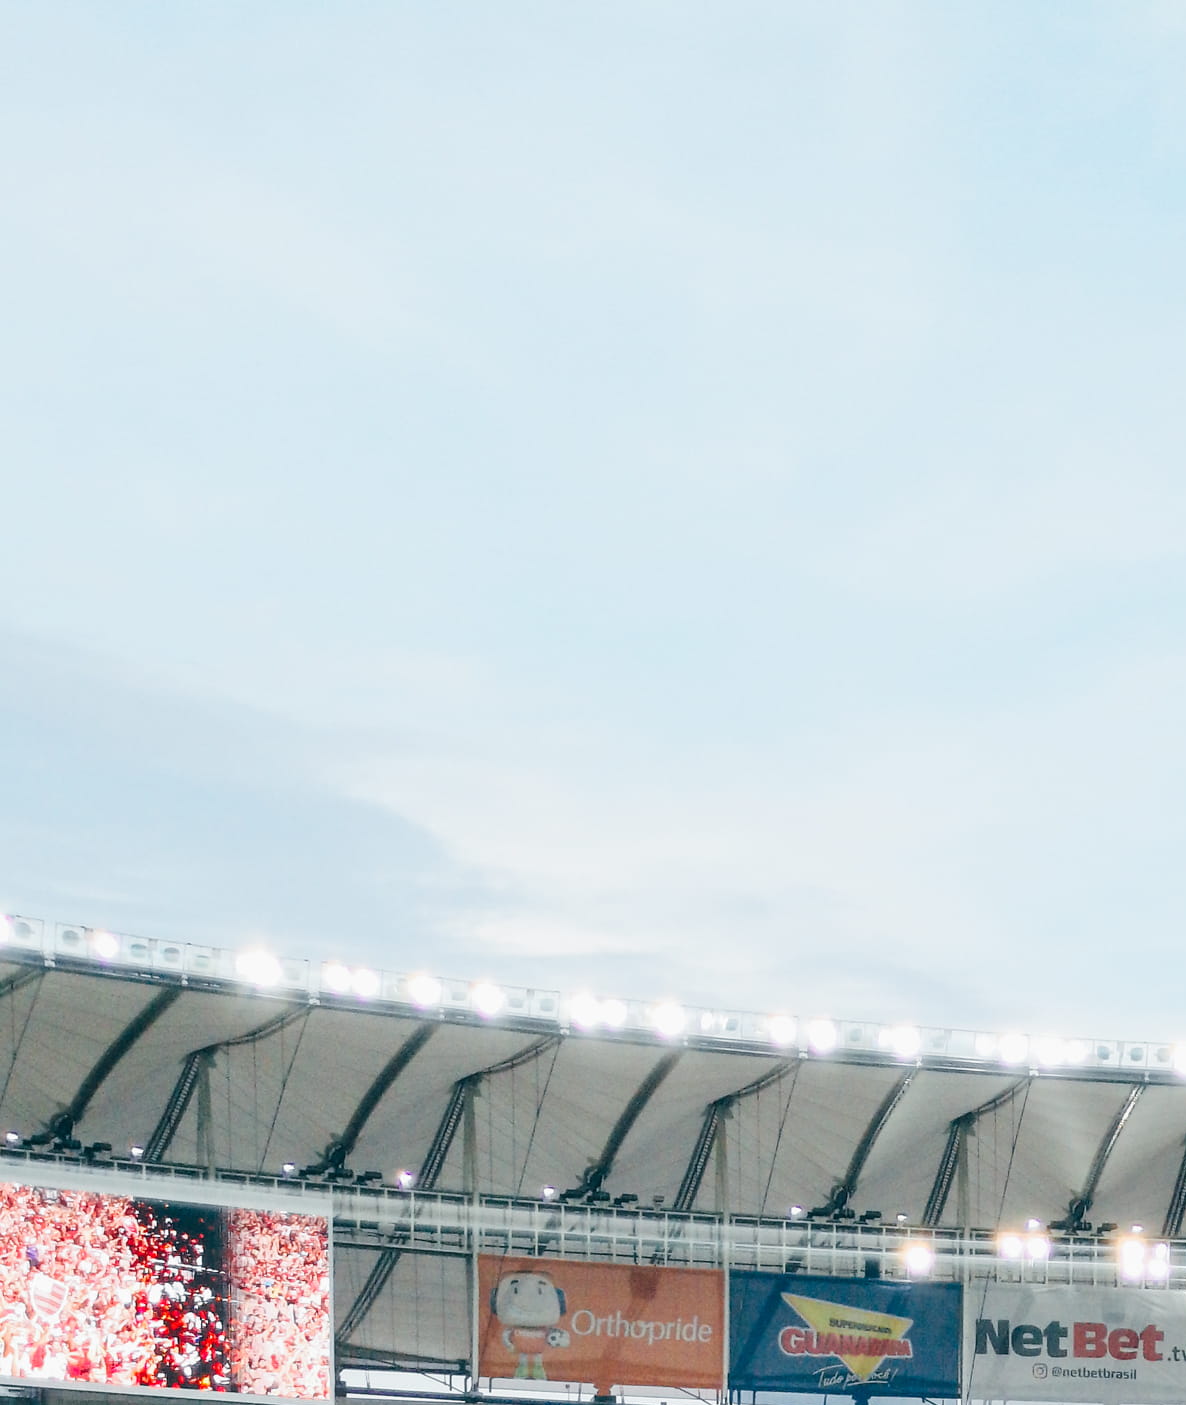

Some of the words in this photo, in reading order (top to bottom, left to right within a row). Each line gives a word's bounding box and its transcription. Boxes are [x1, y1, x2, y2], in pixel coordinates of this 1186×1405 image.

[571, 1310, 712, 1344] Orthopride
[975, 1319, 1164, 1361] NetBet
[1051, 1367, 1137, 1380] @netbetbrasil
